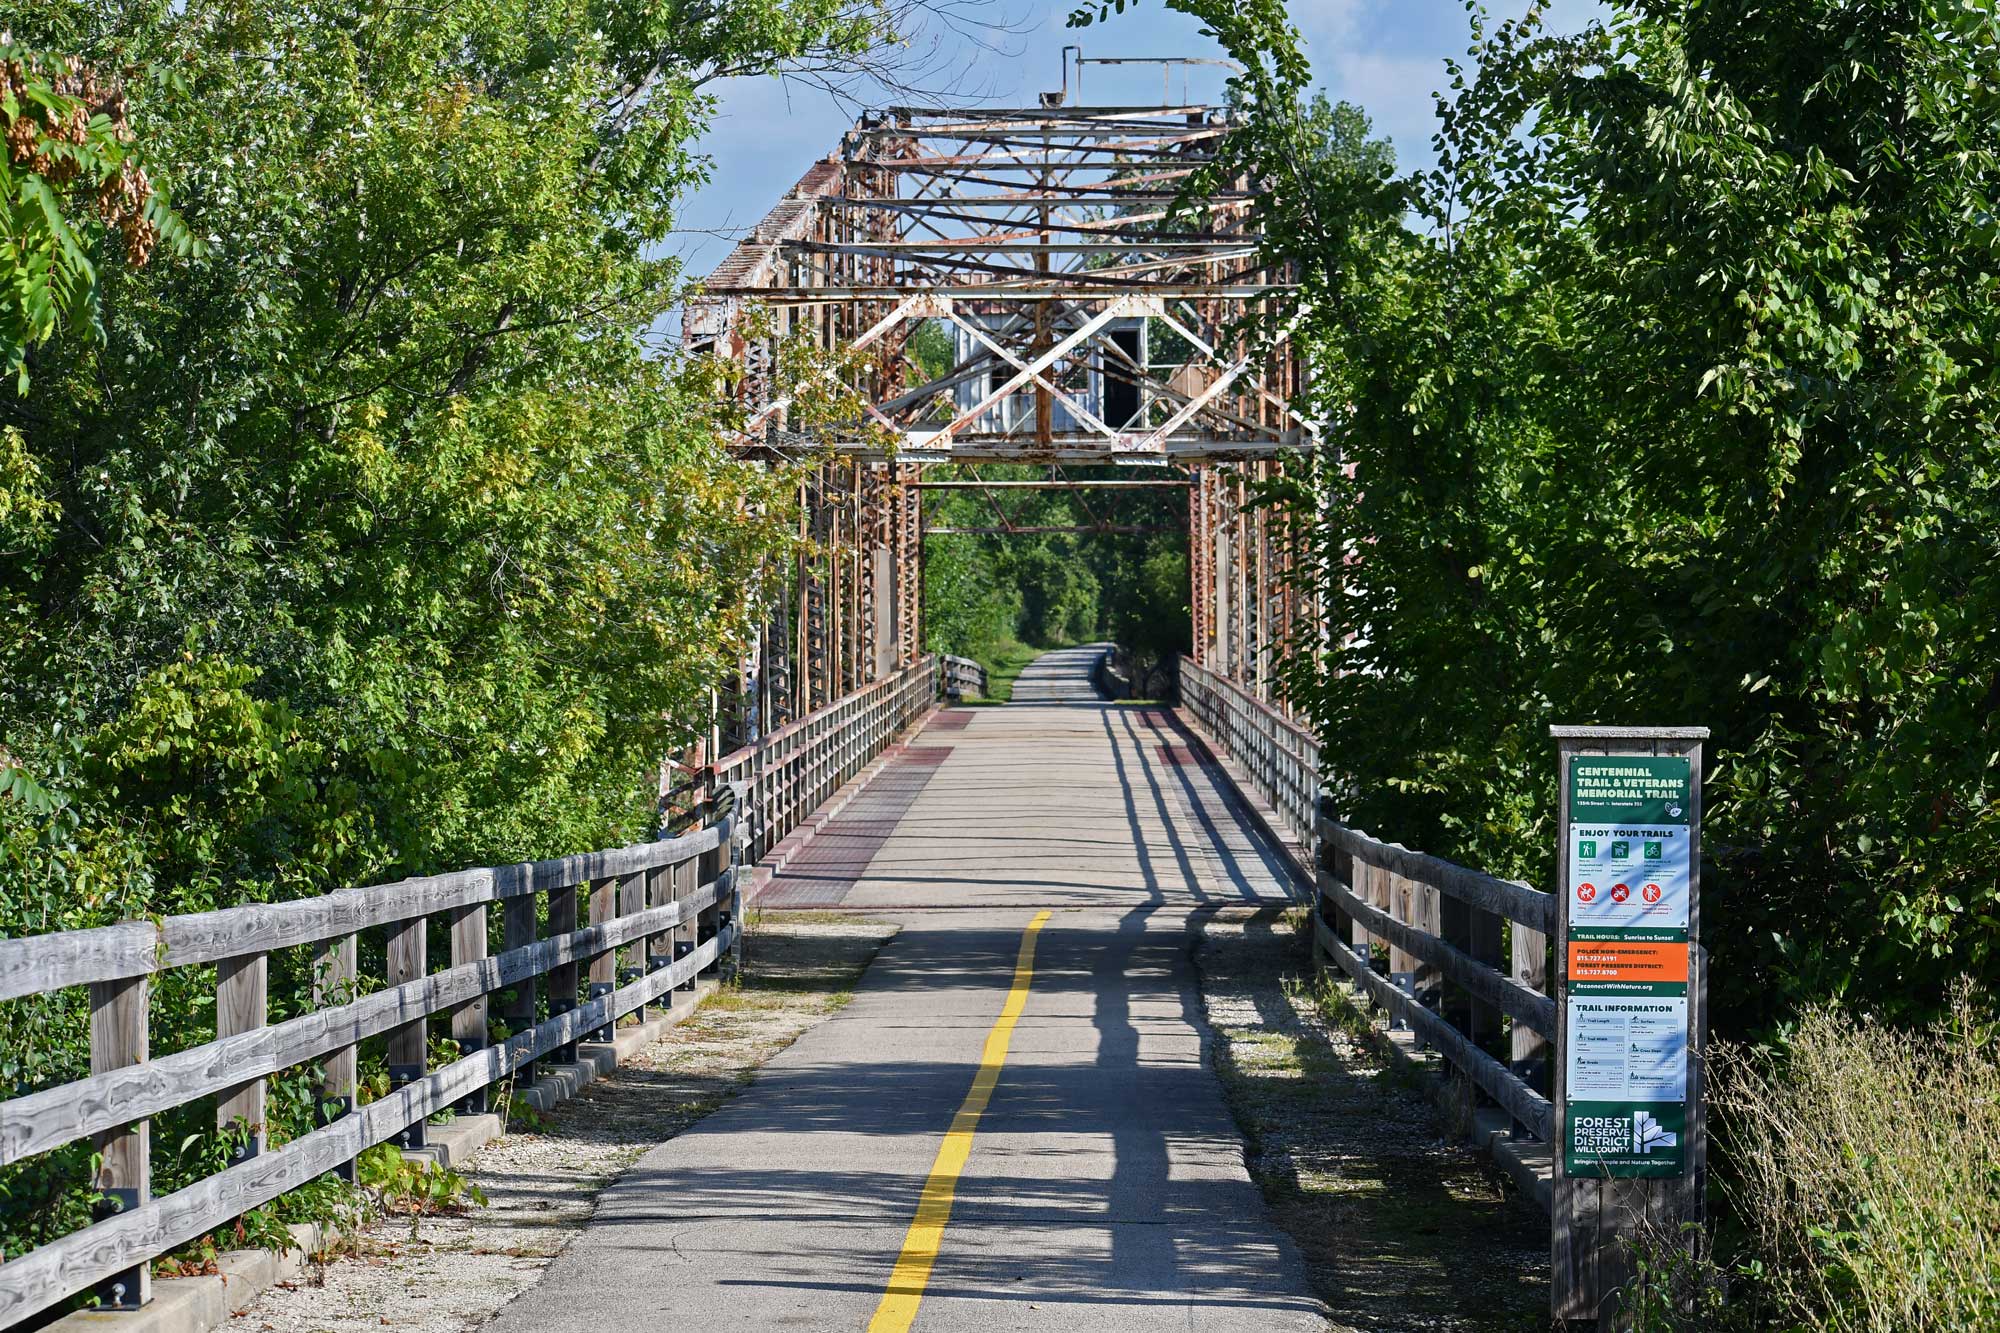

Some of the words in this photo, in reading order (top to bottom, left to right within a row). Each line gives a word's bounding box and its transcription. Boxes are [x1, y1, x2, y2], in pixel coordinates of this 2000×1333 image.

[1577, 767, 1652, 777] CENTENNIAL
[1577, 778, 1611, 787] TRAIL
[1613, 779, 1621, 787] &
[1623, 779, 1684, 788] VETERANS
[1577, 789, 1643, 798] MEMORIAL
[1645, 790, 1679, 799] TRAIL
[1579, 830, 1609, 838] ENJOY
[1613, 830, 1639, 838] YOUR
[1642, 830, 1674, 838] TRAILS
[1576, 983, 1653, 991] ReconnectWithNature.org
[1574, 1117, 1630, 1128] FOREST
[1574, 1128, 1630, 1137] PRESERVE
[1574, 1137, 1630, 1146] DISTRICT
